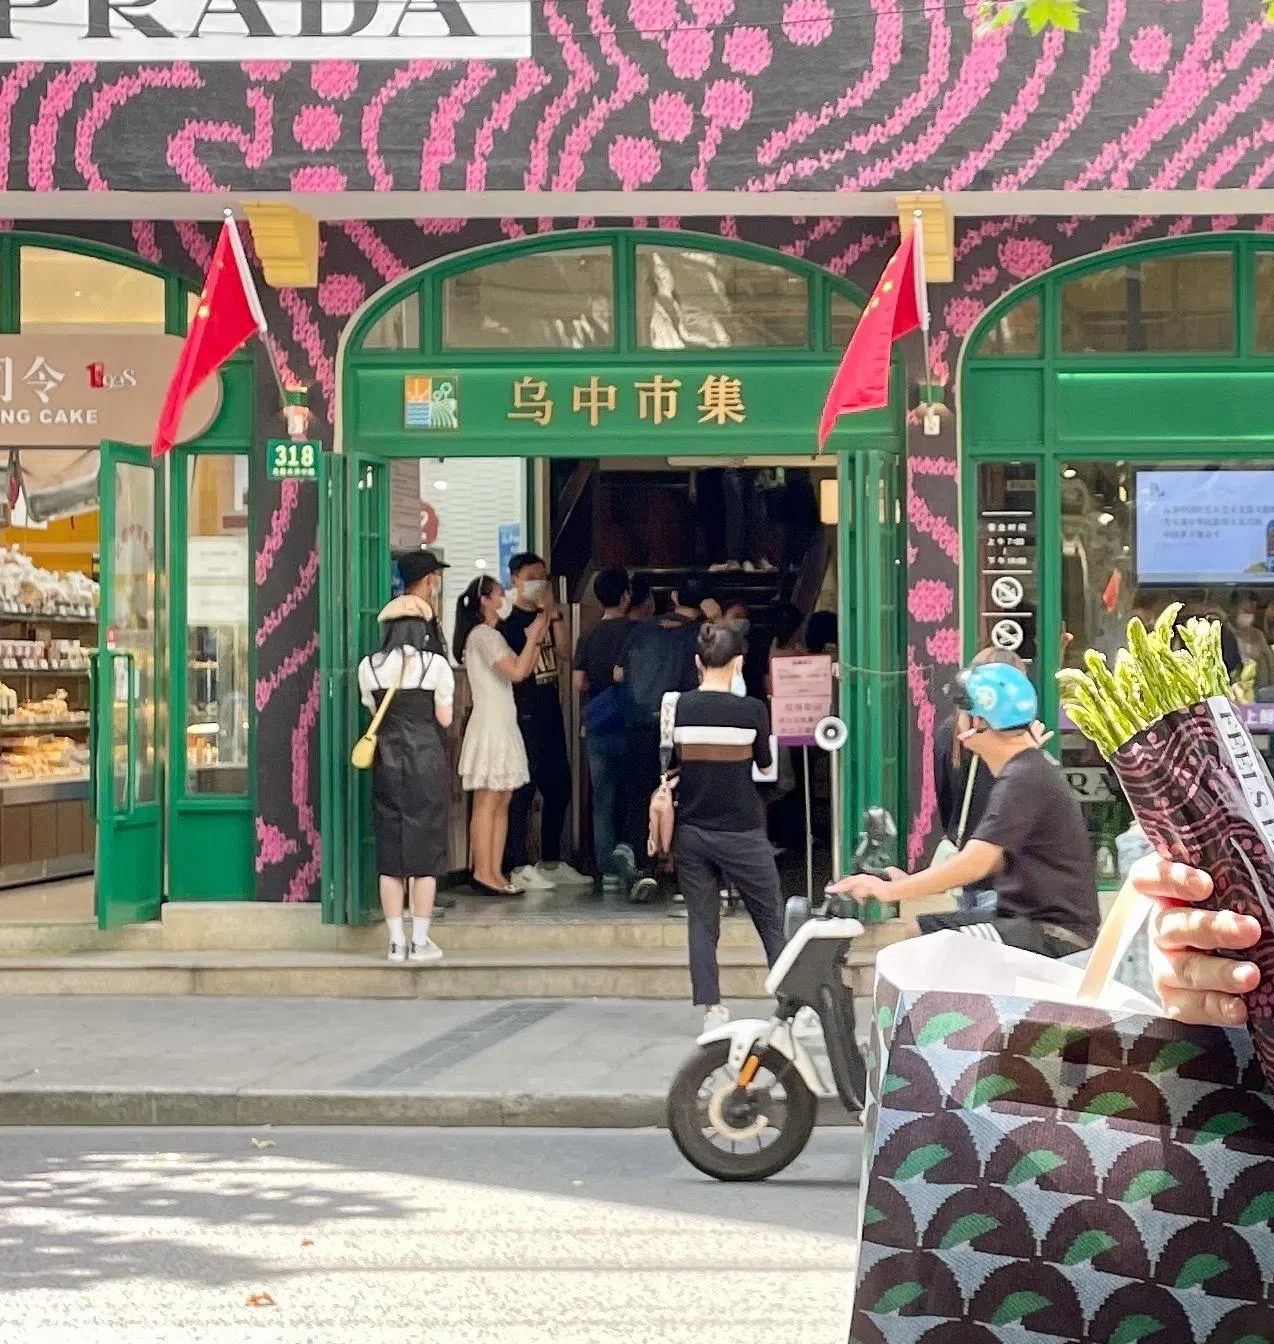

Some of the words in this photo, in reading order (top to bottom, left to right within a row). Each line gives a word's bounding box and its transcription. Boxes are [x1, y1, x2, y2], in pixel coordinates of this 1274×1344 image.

[0, 355, 65, 404] 令
[507, 374, 747, 426] 乌中市集
[39, 409, 98, 424] CAKE
[274, 444, 314, 467] 318
[1219, 712, 1269, 808] FEELS
